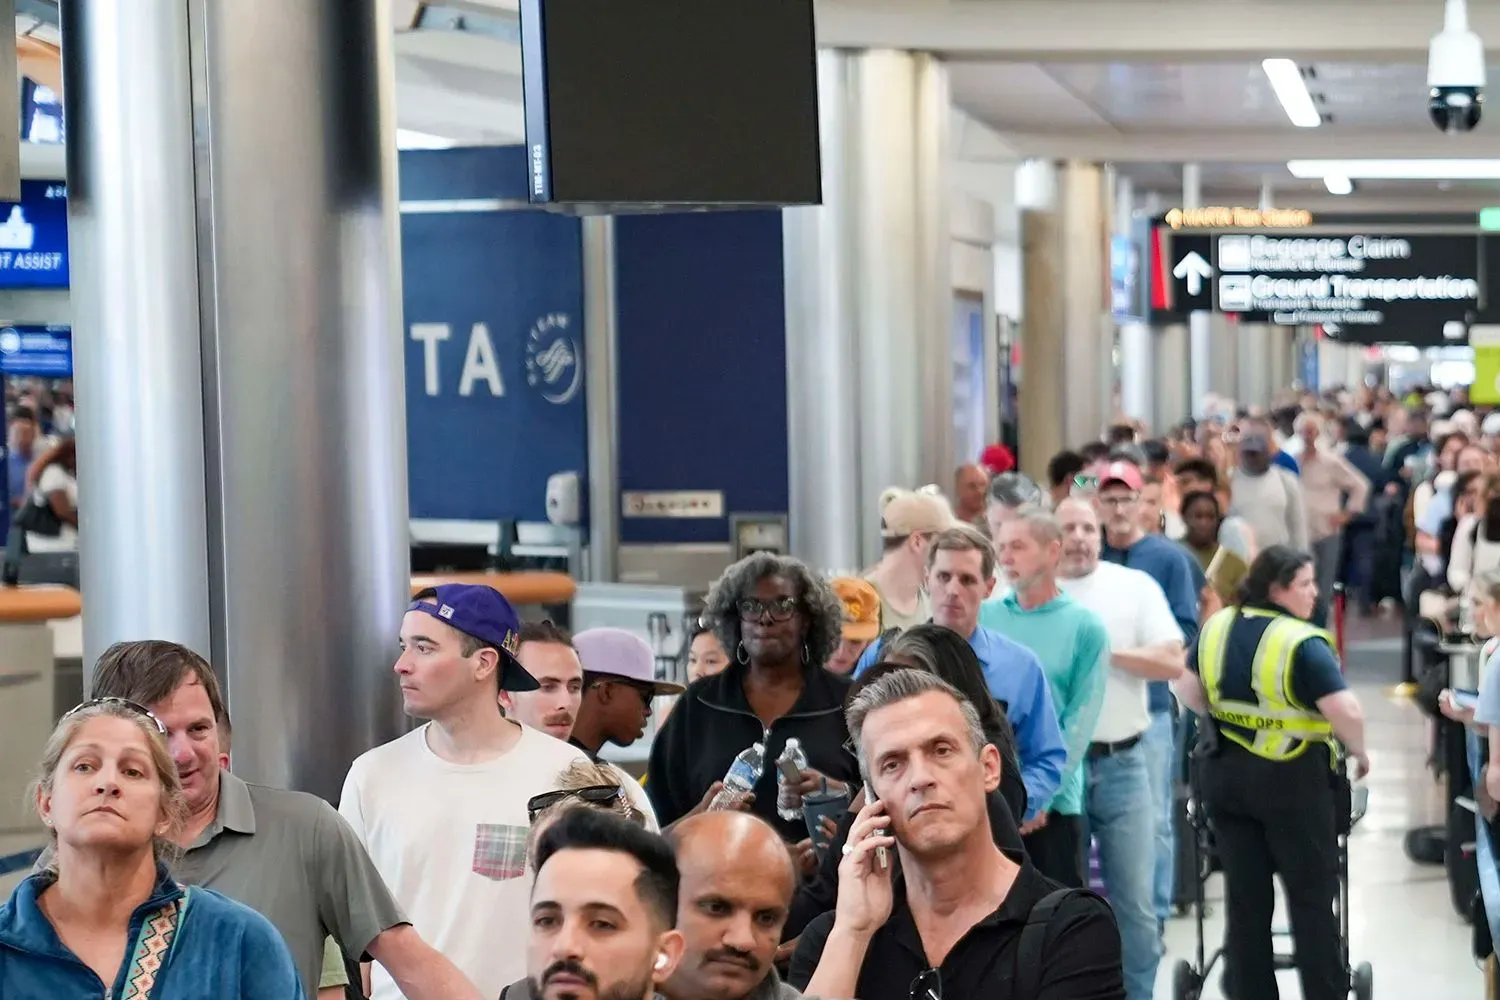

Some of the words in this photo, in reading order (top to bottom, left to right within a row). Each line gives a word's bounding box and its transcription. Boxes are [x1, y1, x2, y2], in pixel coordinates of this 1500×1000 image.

[1251, 235, 1347, 259] Baggage
[1348, 234, 1411, 259] Claim
[13, 252, 62, 269] ASSIST
[1251, 275, 1331, 298] Ground
[1329, 275, 1479, 302] Transportation
[1256, 717, 1284, 730] OPS
